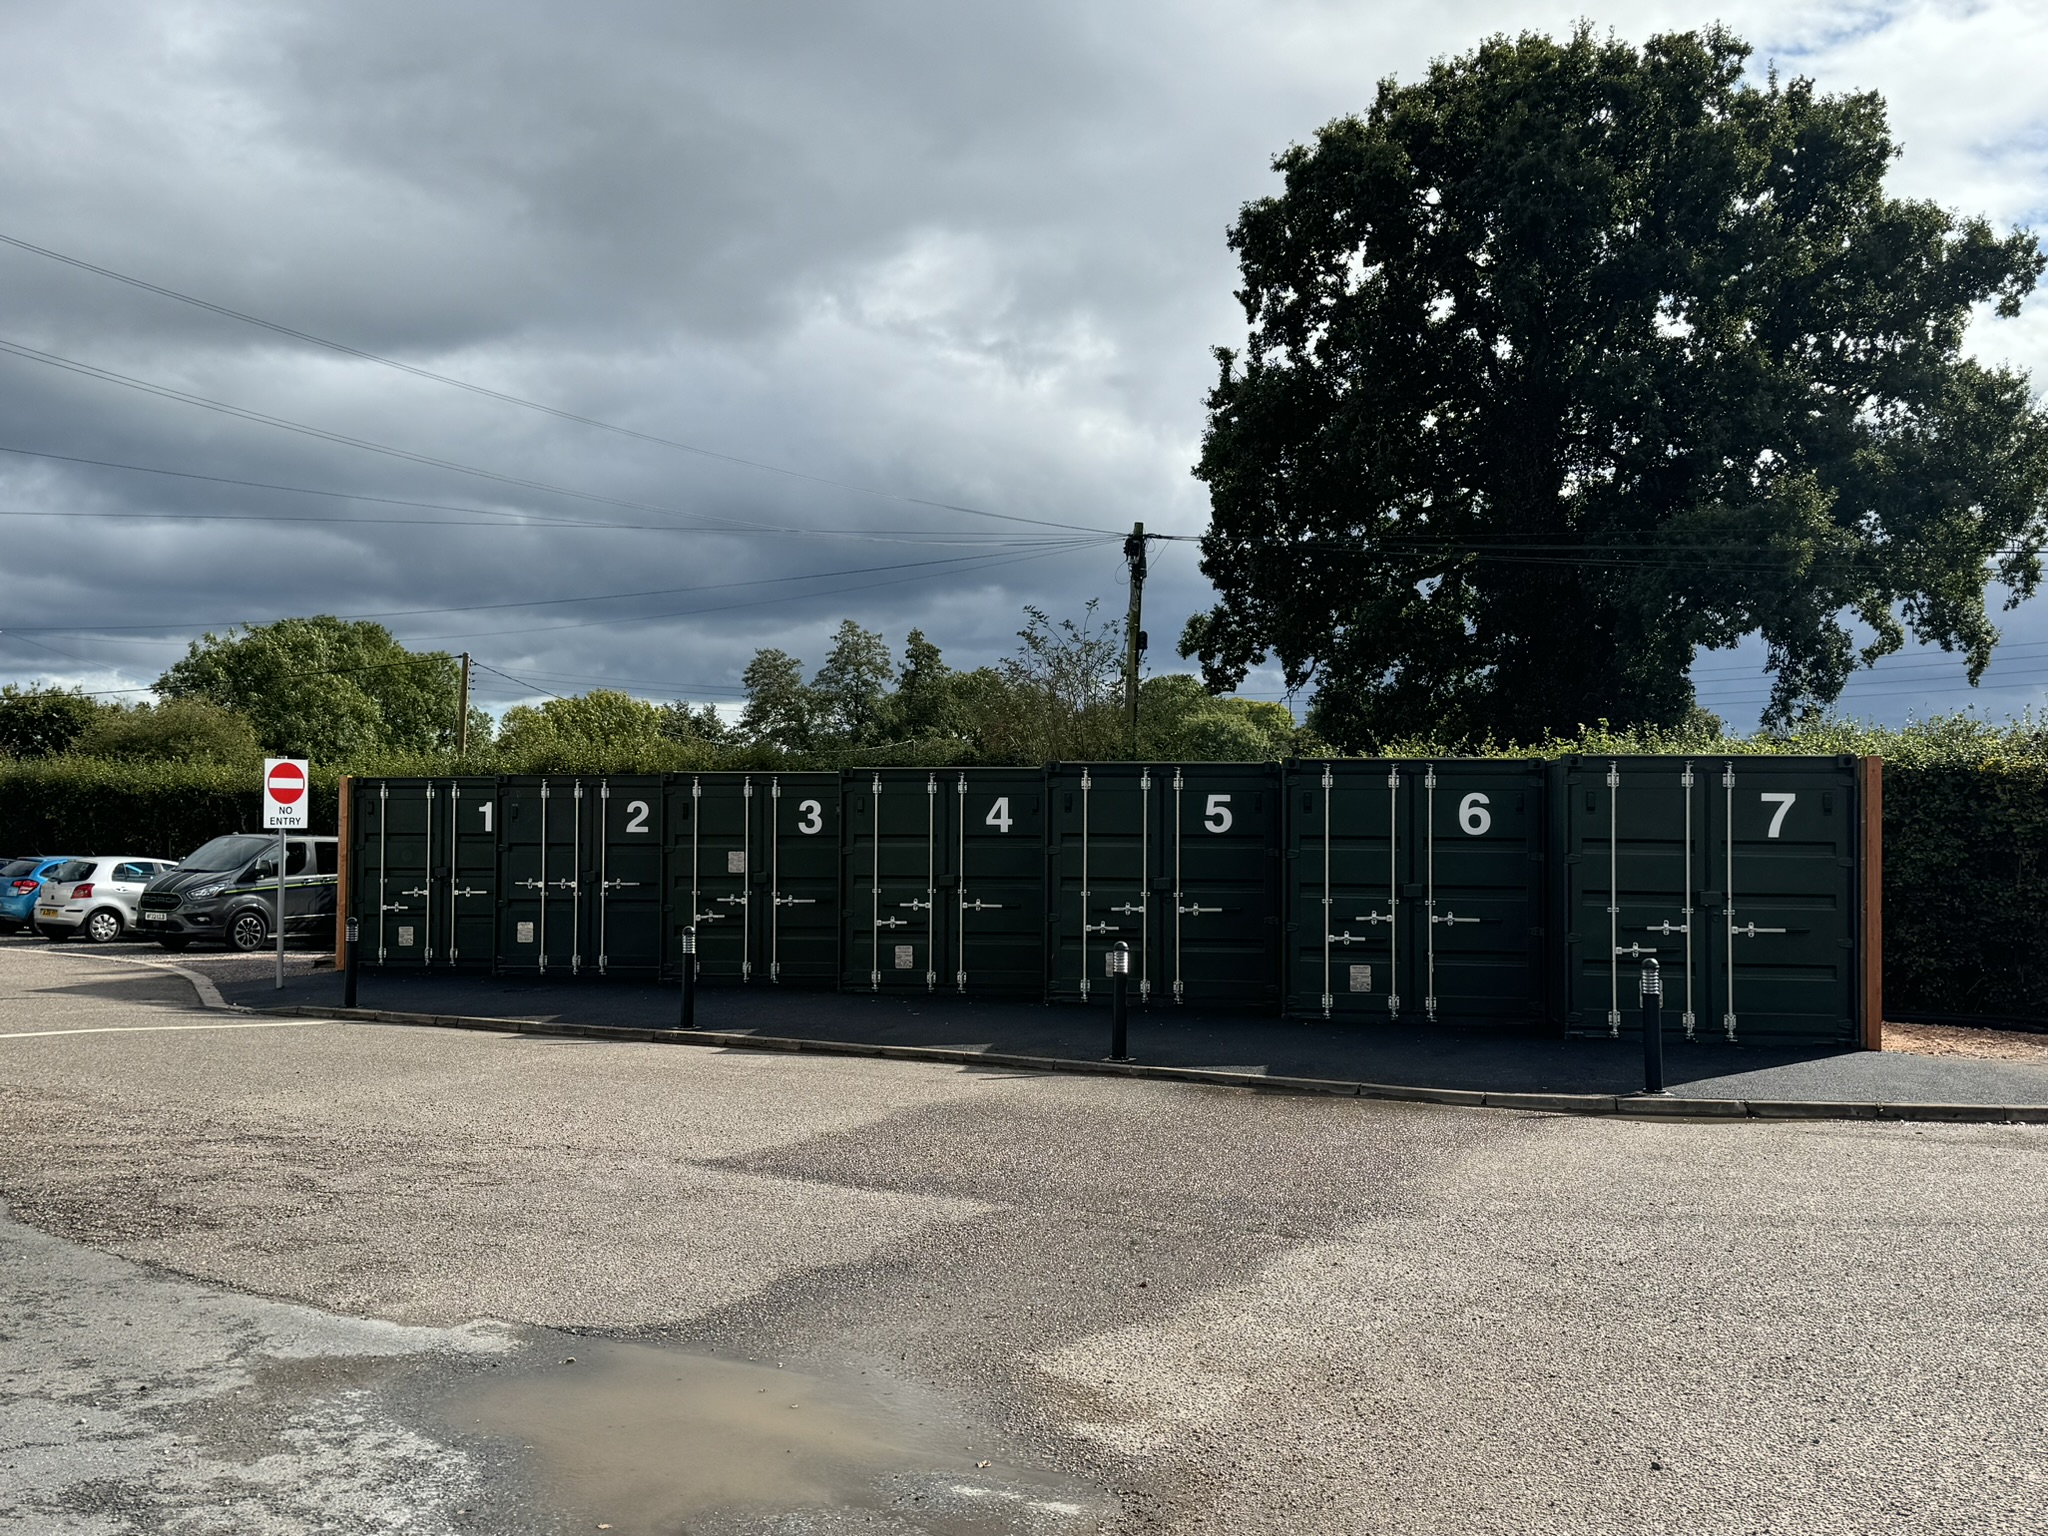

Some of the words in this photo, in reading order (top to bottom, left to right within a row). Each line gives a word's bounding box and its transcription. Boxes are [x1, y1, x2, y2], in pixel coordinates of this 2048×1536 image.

[270, 817, 301, 826] ENTRY
[279, 806, 293, 815] NO
[478, 801, 493, 832] 1
[625, 800, 649, 833] 2
[798, 799, 823, 834] 3
[985, 797, 1013, 833] 4
[1204, 794, 1233, 833] 5
[1458, 792, 1491, 836] 6
[1760, 792, 1796, 838] 7
